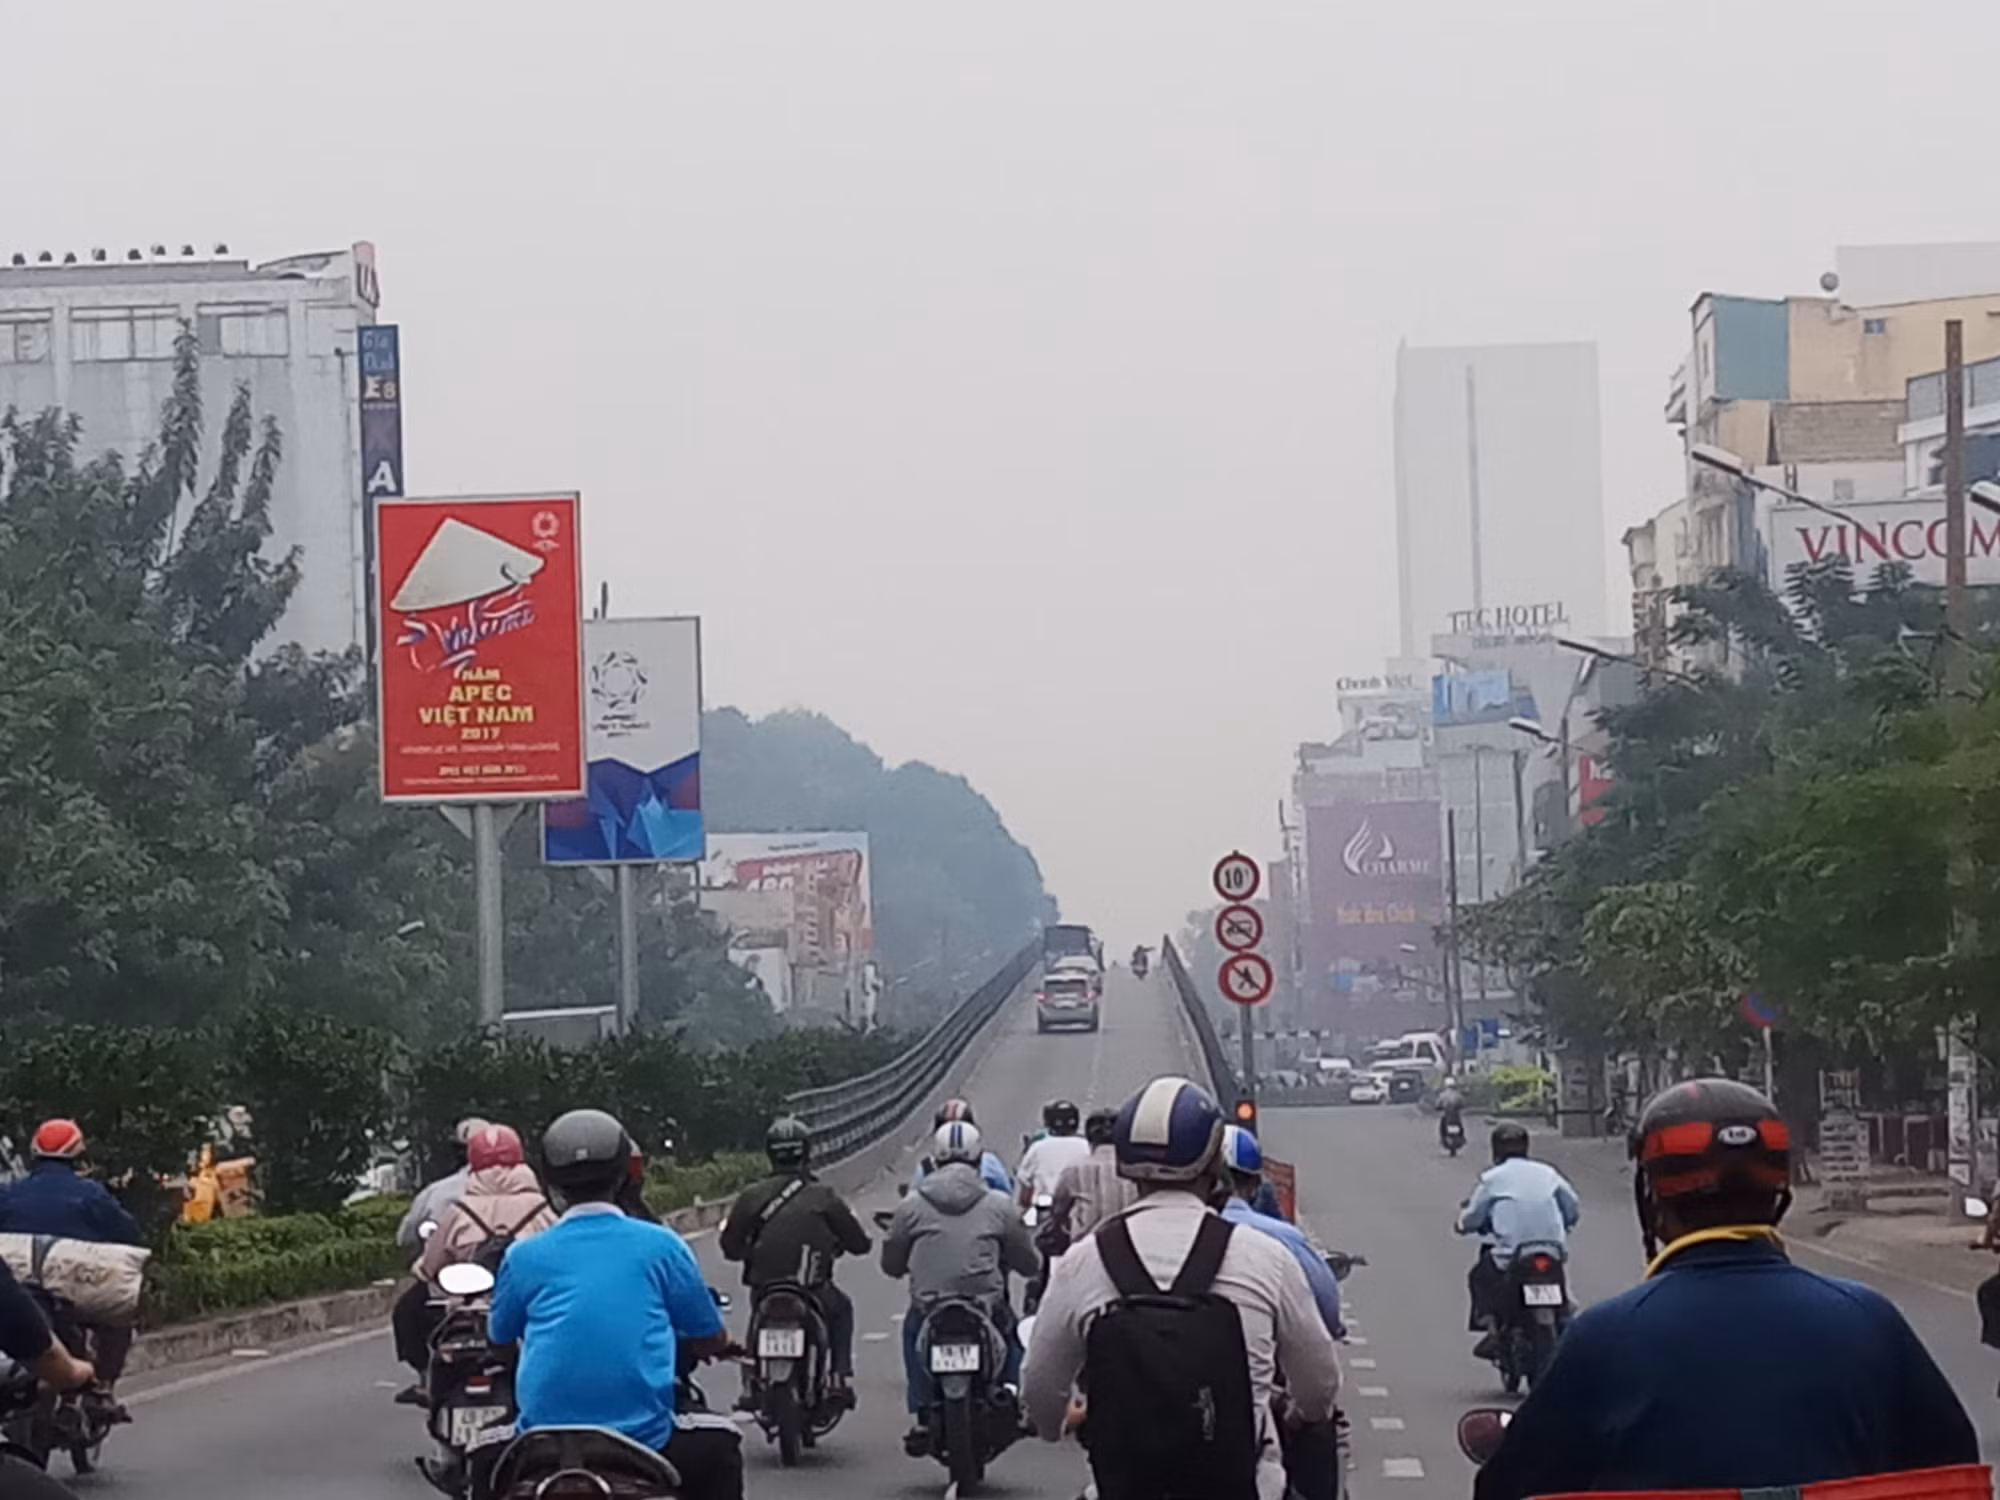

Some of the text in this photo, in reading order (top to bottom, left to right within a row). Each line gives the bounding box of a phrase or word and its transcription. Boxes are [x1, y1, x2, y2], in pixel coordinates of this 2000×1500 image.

[1496, 601, 1568, 629] HOTEL
[449, 684, 512, 702] APEC
[419, 704, 534, 728] VIỆT NAM
[461, 726, 500, 740] 2017
